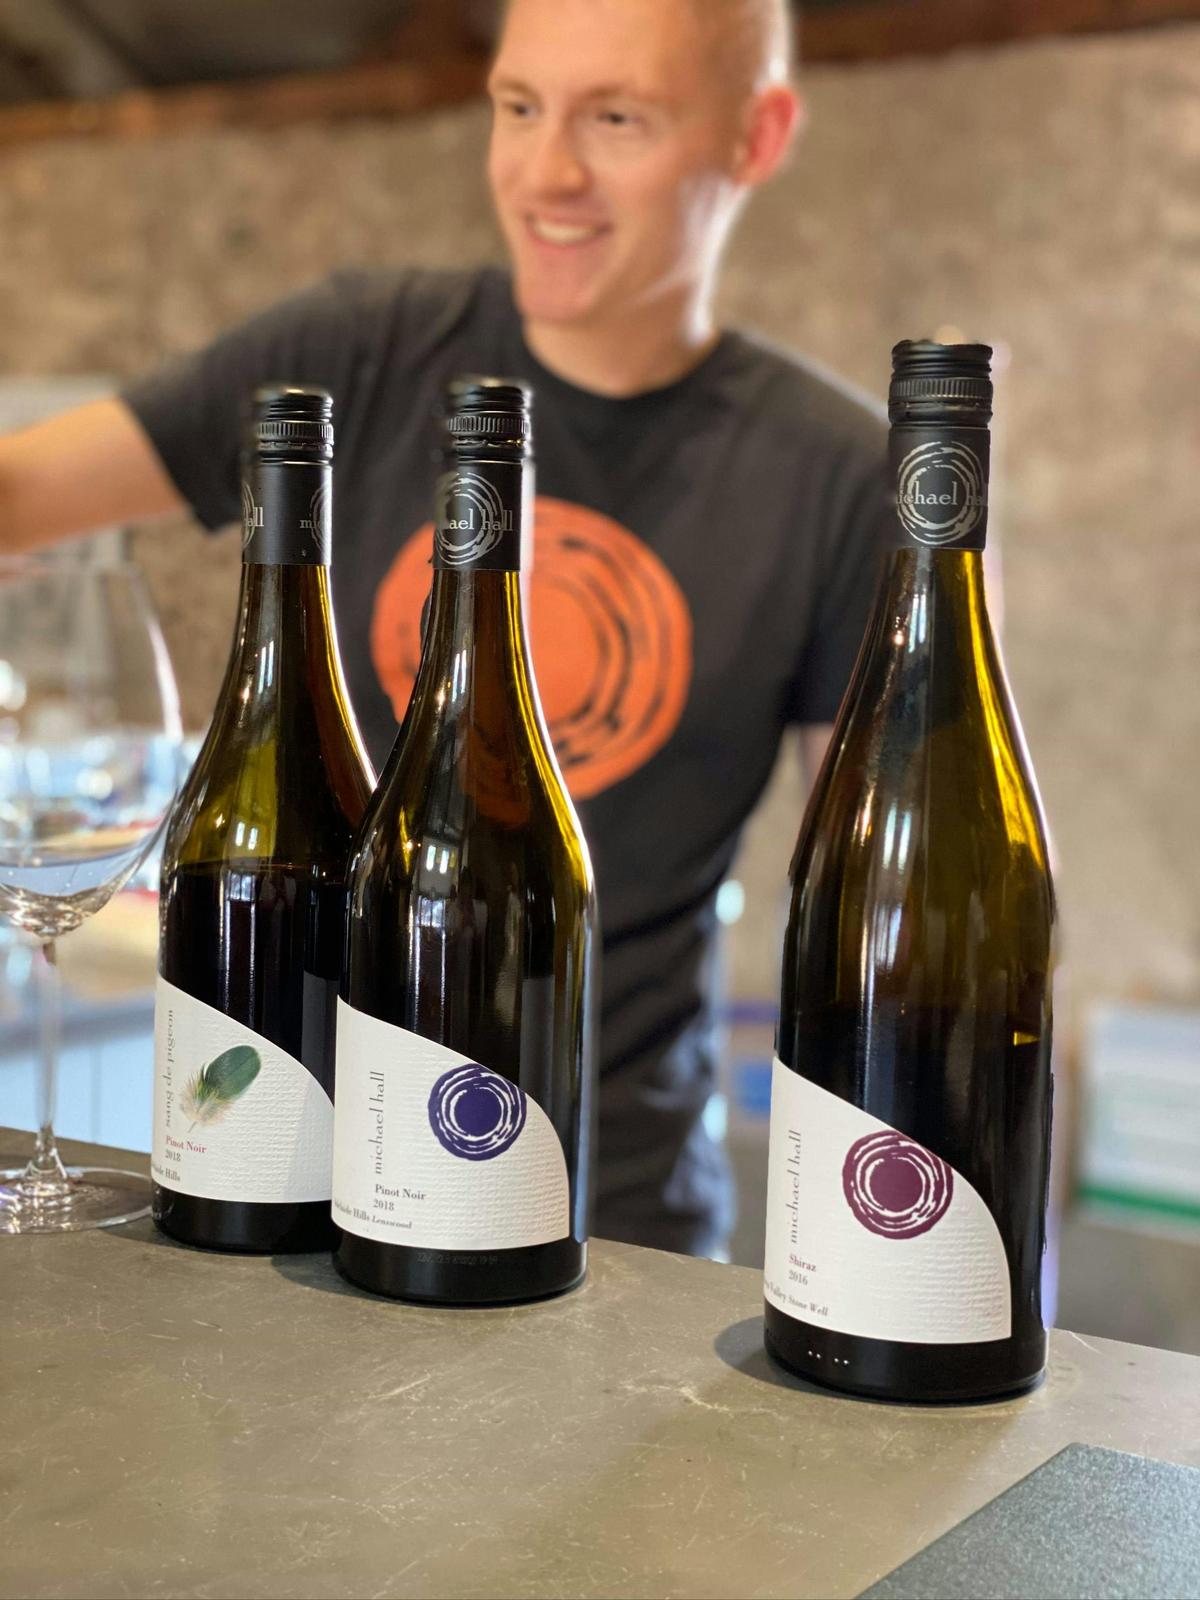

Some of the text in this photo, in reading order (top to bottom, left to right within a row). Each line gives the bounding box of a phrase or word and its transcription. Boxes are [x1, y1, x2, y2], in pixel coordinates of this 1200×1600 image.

[481, 508, 513, 531] hall
[162, 1009, 176, 1127] sang de pigeon
[368, 1071, 385, 1175] michael hall
[166, 1135, 208, 1153] Pinot Noir
[165, 1149, 181, 1162] 2018
[165, 1167, 181, 1181] Hills
[375, 1183, 427, 1201] Pinot Noir
[786, 1130, 802, 1244] michael hall
[373, 1198, 395, 1211] 2018
[353, 1208, 370, 1222] Hills
[371, 1215, 413, 1229] Lenswood
[788, 1253, 817, 1272] Shiraz
[788, 1270, 808, 1286] 2016
[788, 1294, 807, 1309] Stone
[809, 1303, 829, 1317] Well
